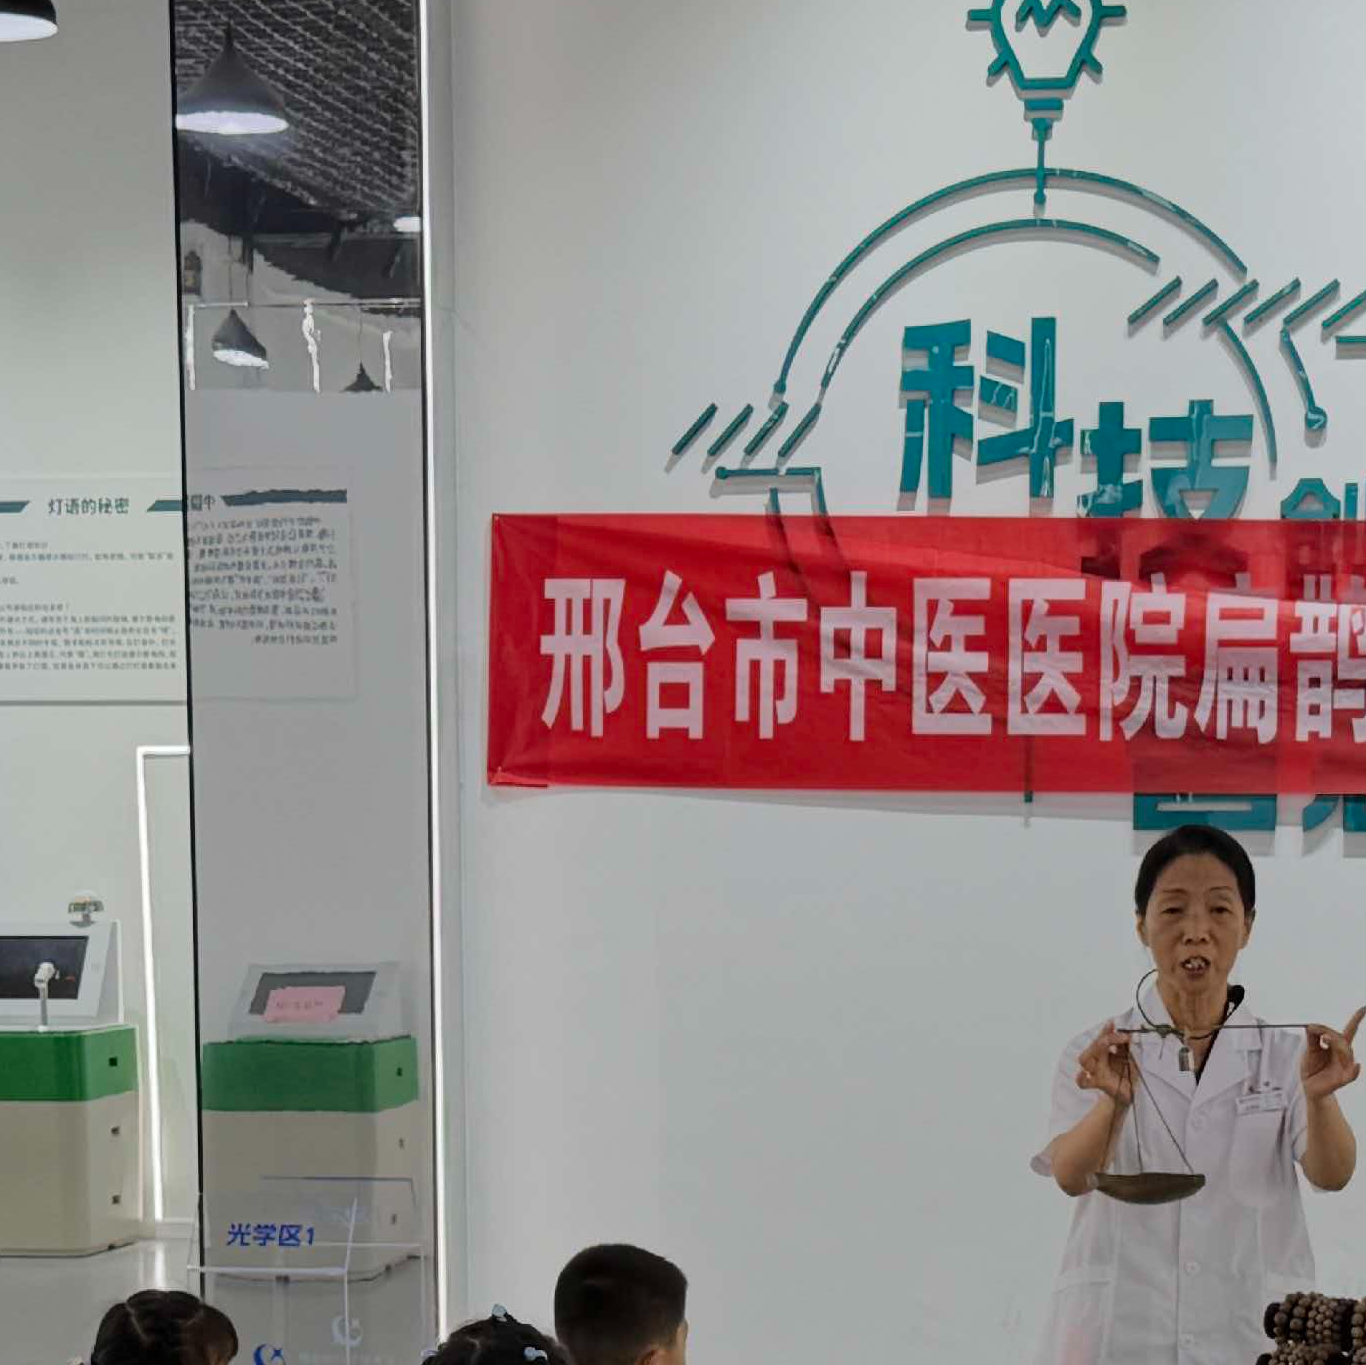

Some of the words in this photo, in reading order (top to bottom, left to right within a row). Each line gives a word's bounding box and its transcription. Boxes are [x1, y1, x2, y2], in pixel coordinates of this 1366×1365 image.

[900, 316, 1255, 580] 科技
[227, 1223, 316, 1247] 光学区1
